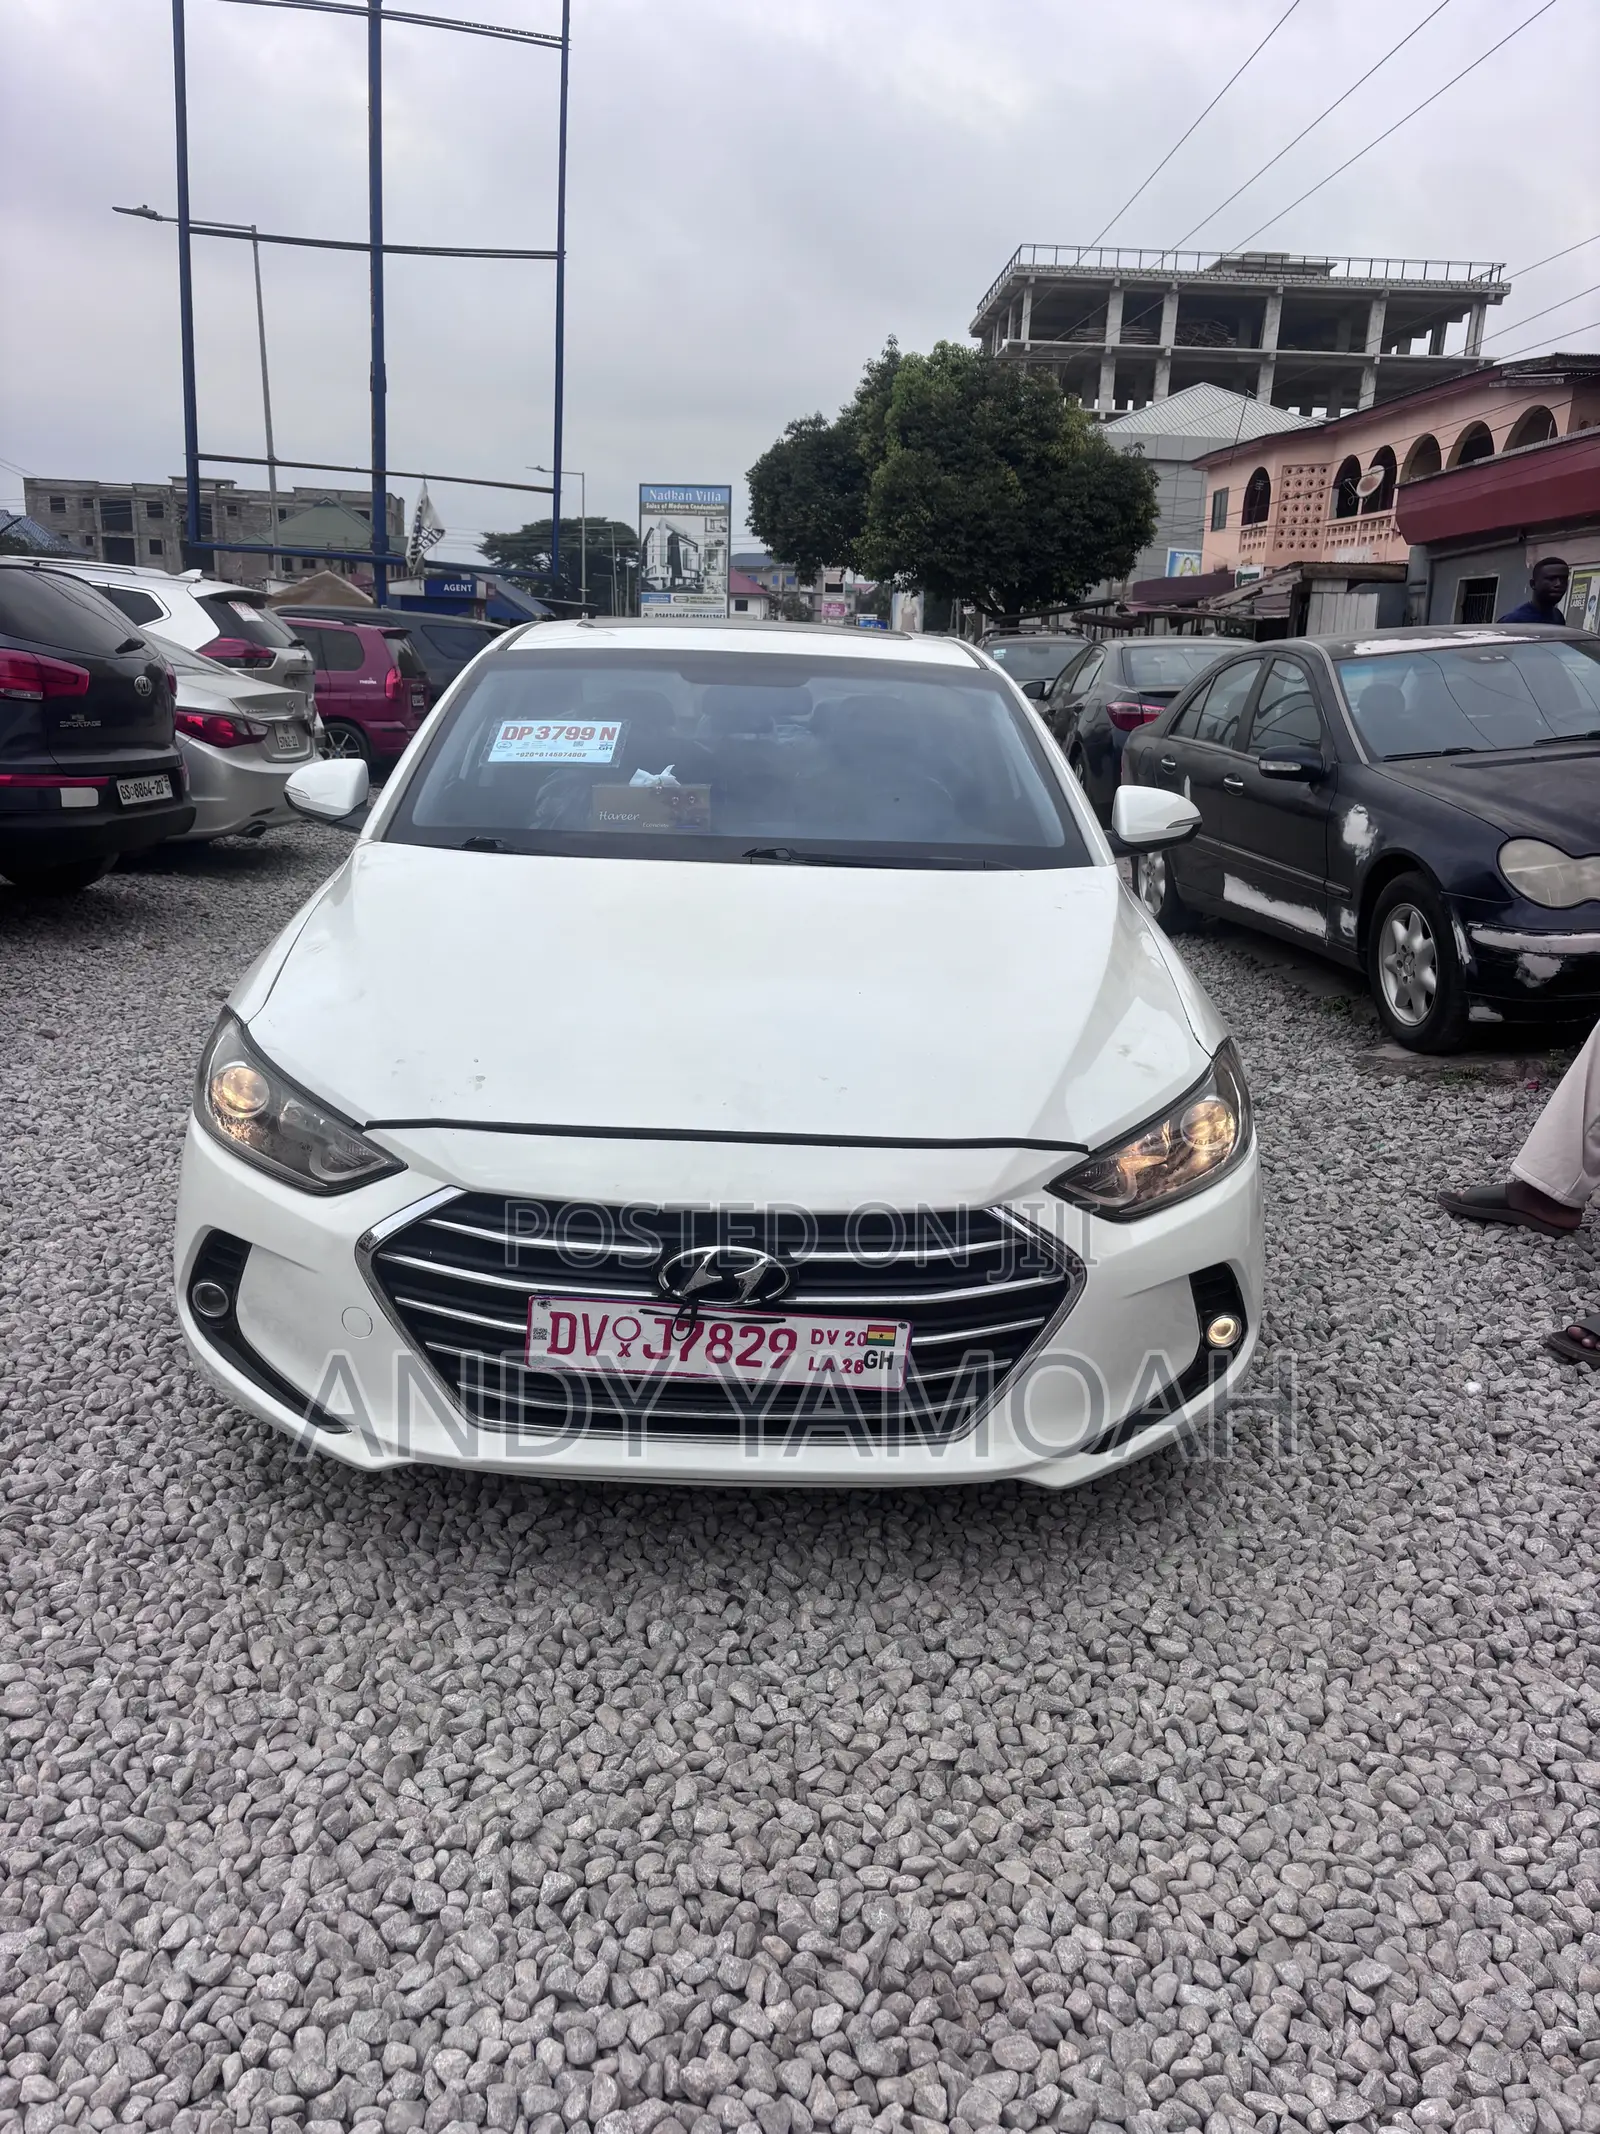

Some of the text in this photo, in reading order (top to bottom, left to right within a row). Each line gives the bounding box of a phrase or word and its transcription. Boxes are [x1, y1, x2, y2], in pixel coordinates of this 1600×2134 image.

[695, 490, 721, 501] Villa
[443, 583, 472, 592] AGENT
[501, 726, 617, 741] DP 3799 N
[599, 810, 641, 821] Hareer
[546, 1311, 610, 1357] DV
[642, 1317, 798, 1370] J7829
[811, 1328, 867, 1347] DV 20
[808, 1355, 836, 1373] LA
[863, 1349, 894, 1371] GH
